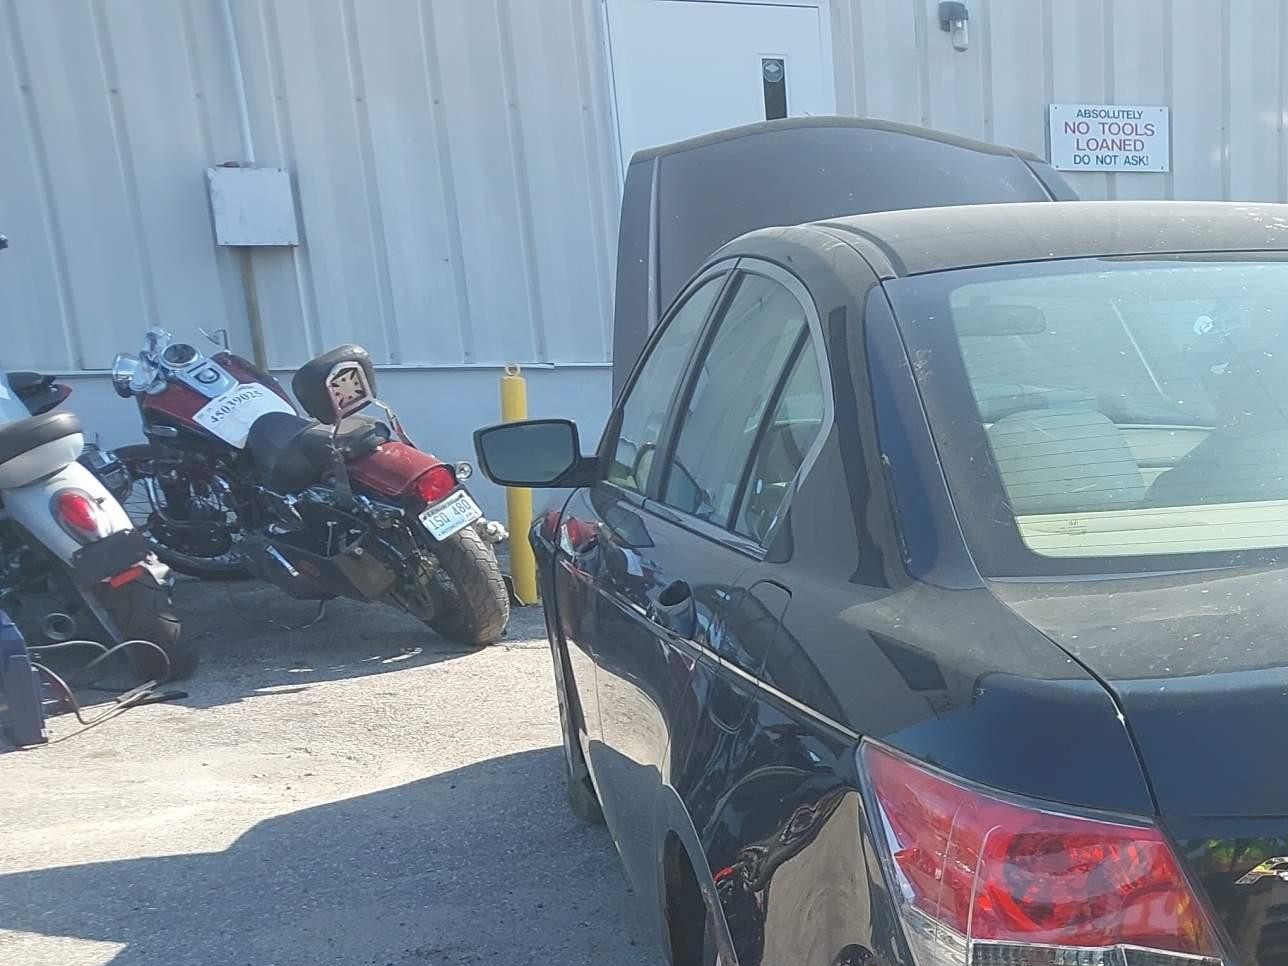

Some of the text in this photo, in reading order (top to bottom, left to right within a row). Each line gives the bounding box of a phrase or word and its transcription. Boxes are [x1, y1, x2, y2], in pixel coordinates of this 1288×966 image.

[1076, 109, 1144, 120] ABSOLUTELY
[1064, 121, 1155, 137] NO TOOLS
[1076, 138, 1145, 152] LOANED
[1073, 154, 1149, 167] DO NOT ASK!
